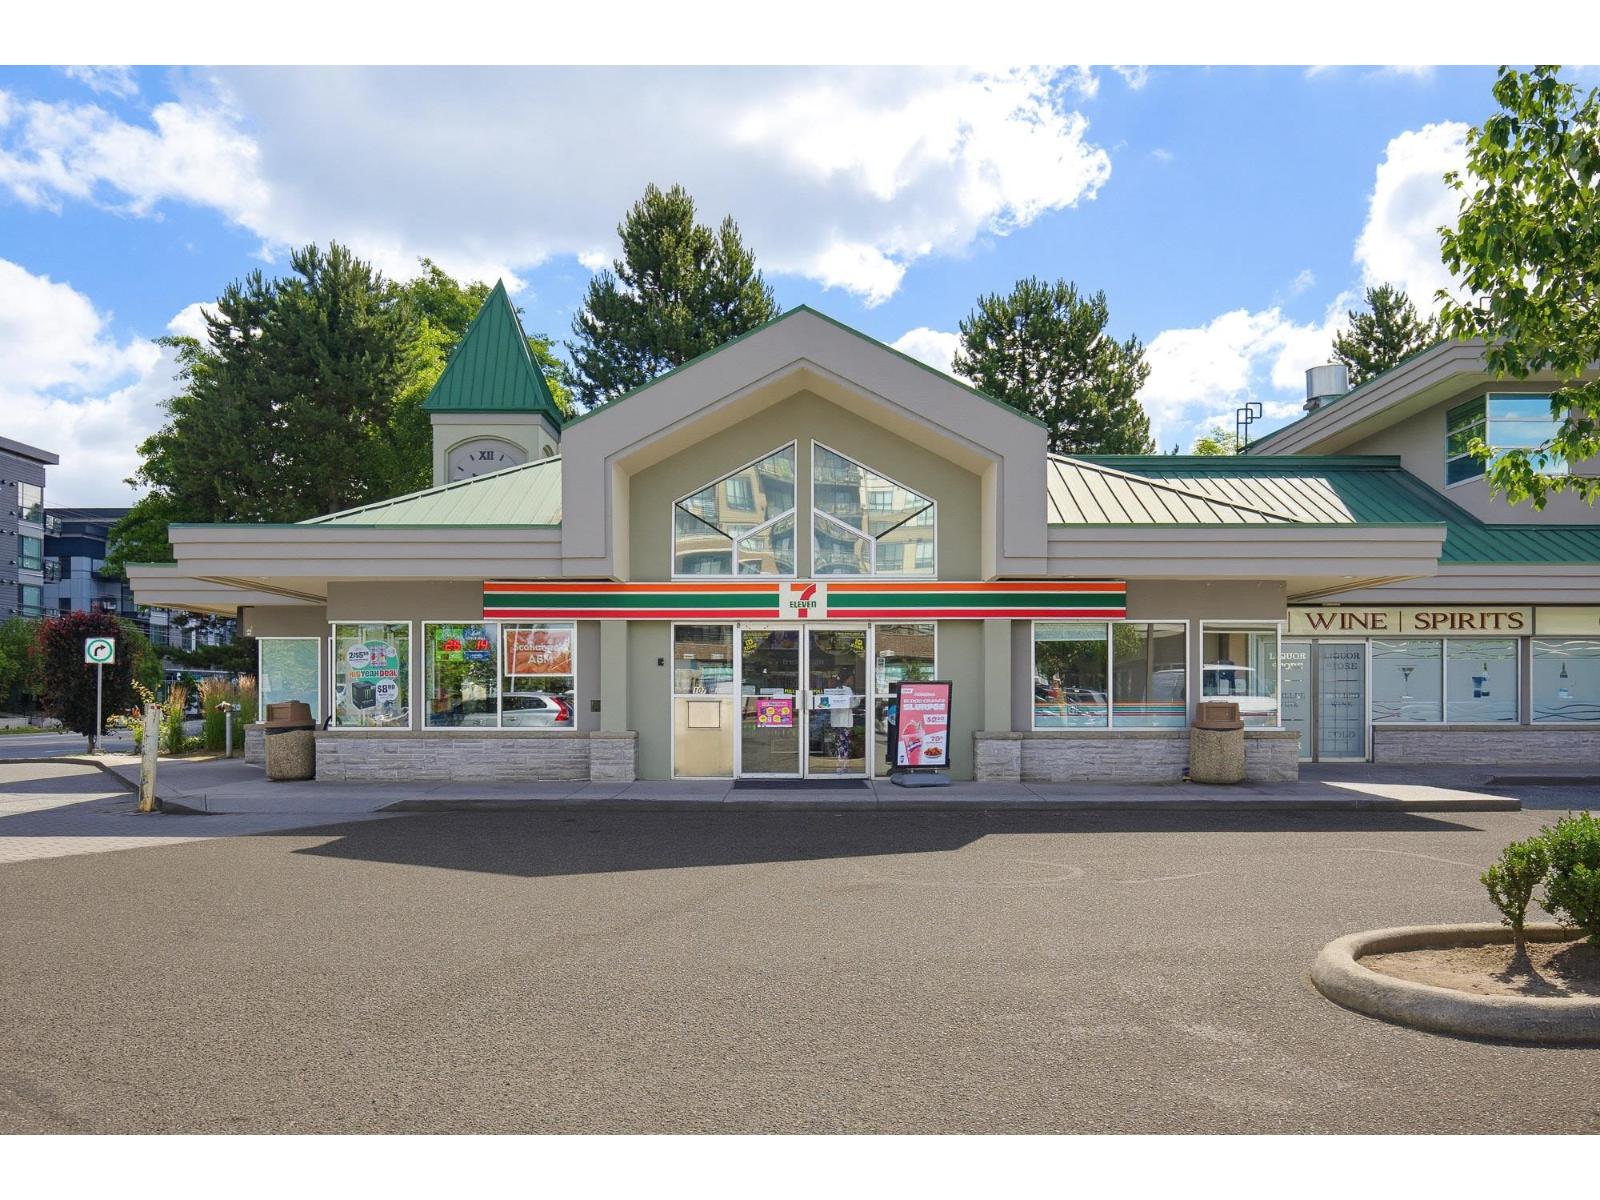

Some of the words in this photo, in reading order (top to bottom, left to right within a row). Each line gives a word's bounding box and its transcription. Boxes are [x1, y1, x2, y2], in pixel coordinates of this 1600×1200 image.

[479, 451, 495, 460] XII
[790, 583, 817, 618] 7
[1304, 612, 1388, 630] WINE
[1414, 611, 1524, 630] SPIRITS
